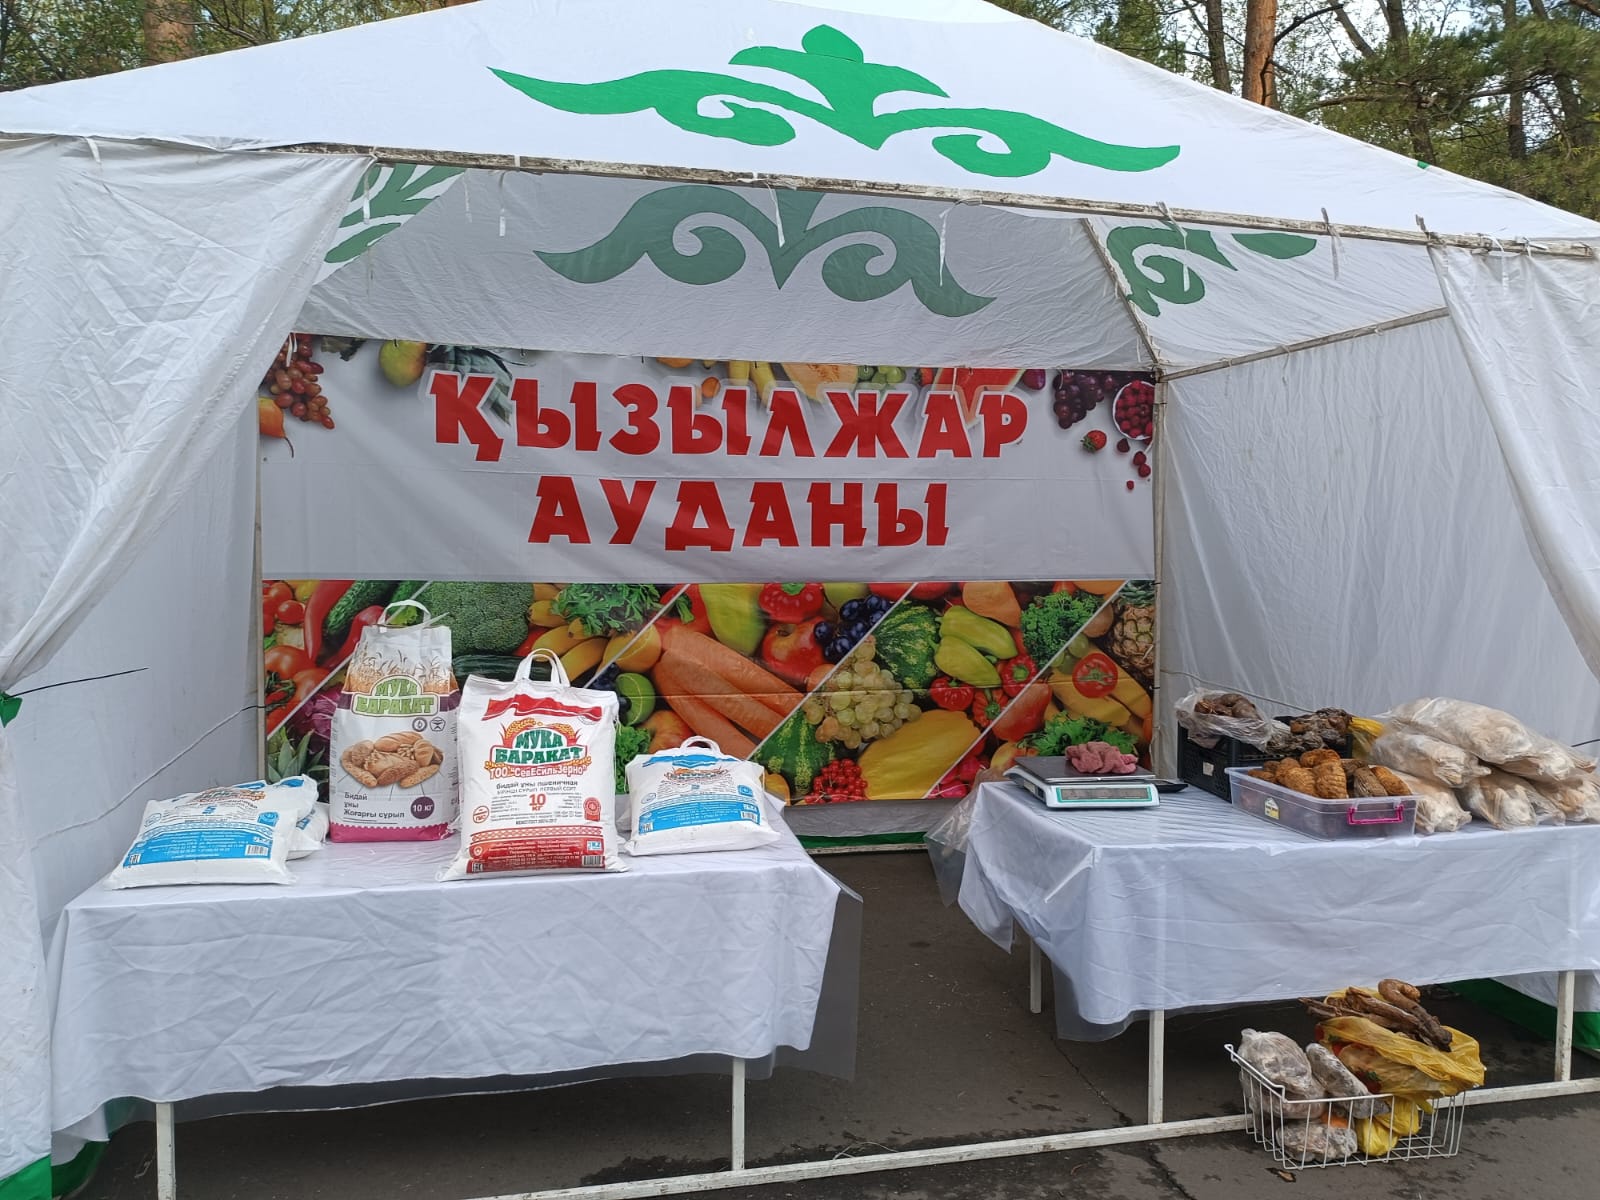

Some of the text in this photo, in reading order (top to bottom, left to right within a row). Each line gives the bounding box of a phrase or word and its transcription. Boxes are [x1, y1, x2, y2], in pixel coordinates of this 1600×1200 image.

[429, 373, 1028, 462] ҚЫЗЫЛЖАР
[528, 475, 949, 552] АУДАНЫ
[375, 679, 417, 696] МУКА
[356, 696, 434, 714] БАРАКАТ
[515, 729, 563, 749] МУКА
[495, 747, 584, 764] БАРАКАТ
[344, 791, 368, 801] Бидай
[529, 793, 546, 806] 10
[412, 804, 422, 812] 10
